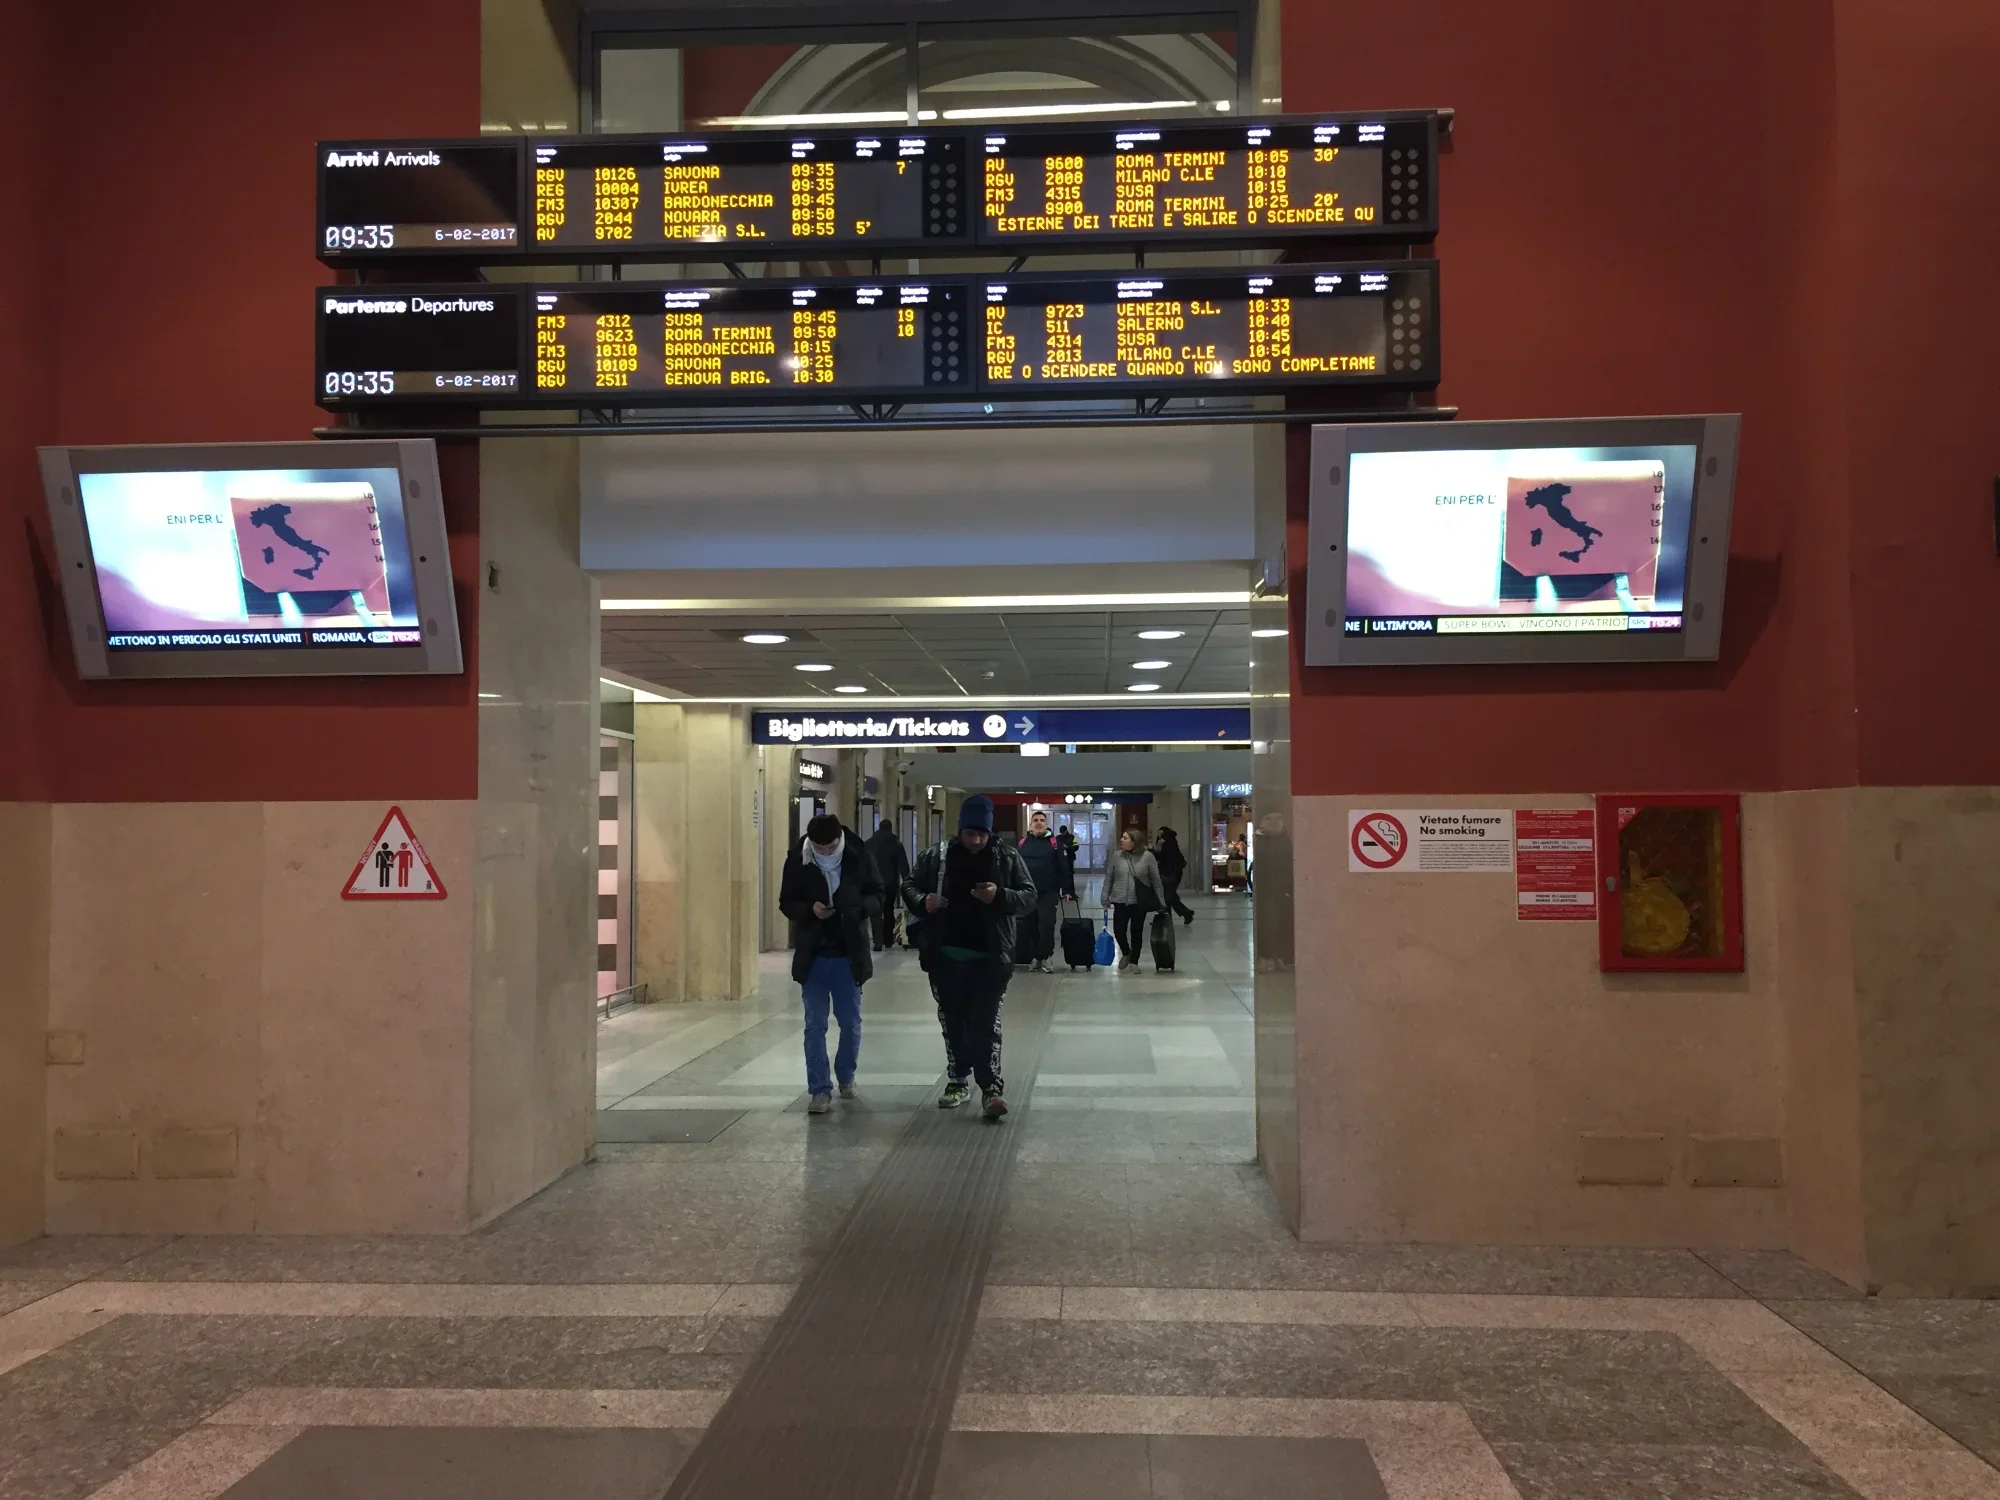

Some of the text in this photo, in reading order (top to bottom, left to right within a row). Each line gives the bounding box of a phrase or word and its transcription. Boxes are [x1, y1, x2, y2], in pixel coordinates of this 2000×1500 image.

[326, 151, 440, 167] Arrivi Arrivals
[986, 158, 1004, 172] AV
[1045, 157, 1083, 170] 9600
[1116, 154, 1153, 168] ROMA
[1164, 152, 1226, 166] TERMINI
[1248, 150, 1288, 164] 10:05
[536, 169, 564, 181] RGV
[595, 168, 636, 181] 10126
[664, 166, 720, 179] SAVONA
[792, 164, 834, 177] 09:35
[986, 165, 1286, 187] RGV 2008 MILANO C.LE 10:10
[536, 179, 834, 196] REG 10004 IVREA 09:35
[986, 180, 1286, 202] FM3 4315 SUSA 10:15
[536, 193, 834, 211] FM3 10307 BARDONECCHIA 09:45
[986, 203, 1004, 217] AV
[1045, 201, 1083, 215] 9900
[1116, 199, 1153, 213] ROMA
[1164, 196, 1225, 211] TERMINI
[1248, 195, 1288, 209] 10:25
[536, 208, 834, 226] RGV 2044 NOVARA 09:50
[998, 207, 1374, 231] ESTERNE DEI TRENI E SALIRE O SCENDERE QU
[326, 225, 516, 249] 09:35 6-02-2017
[536, 228, 555, 241] AV
[595, 227, 633, 239] 9702
[664, 225, 727, 239] VENEZIA
[736, 224, 765, 237] S.L.
[792, 223, 834, 236] 09:55
[325, 297, 494, 315] Partenze Departures
[987, 299, 1290, 320] AV 9723 VENEZIA S.L. 10:33
[537, 309, 914, 329] FM3 4312 SUSA 09:45 19
[987, 314, 1290, 335] IC 511 SALERNO 10:40
[537, 324, 914, 343] AV 9623 ROMA TERMINI 09:50 10
[986, 330, 1290, 350] FM3 4314 SUSA 10:45
[537, 340, 830, 358] FM3 10310 BARDONECCHIA 10:15
[987, 344, 1291, 365] RGV 2013 MILANO C.LE 10:54
[537, 355, 834, 373] RGV 10109 SAVONA 10:25
[1022, 365, 1032, 378] O
[1041, 363, 1117, 378] SCENDERE
[1127, 361, 1184, 376] QUANDO
[1194, 360, 1223, 375] NON
[1233, 359, 1271, 374] SONO
[1281, 356, 1375, 372] COMPLETAME
[325, 371, 516, 395] 09:35 6-02-2017
[537, 370, 834, 388] RGV 2511 GENOVA BRIG. 10:30
[1459, 494, 1484, 505] PER
[189, 514, 212, 524] PER
[1345, 621, 1360, 631] NE
[1372, 619, 1432, 631] ULTIM'ORA
[1445, 620, 1478, 630] SUPER
[1519, 618, 1571, 629] VINCONO
[158, 635, 171, 645] IN
[172, 634, 222, 645] PERICOLO
[223, 634, 241, 644] GLI
[242, 633, 272, 644] STATI
[272, 633, 302, 643] UNITI
[768, 717, 969, 741] Biglietteria/Tickets
[1420, 815, 1501, 825] Vietato fumare
[1420, 826, 1485, 837] No smoking
[411, 838, 429, 865] WARNING
